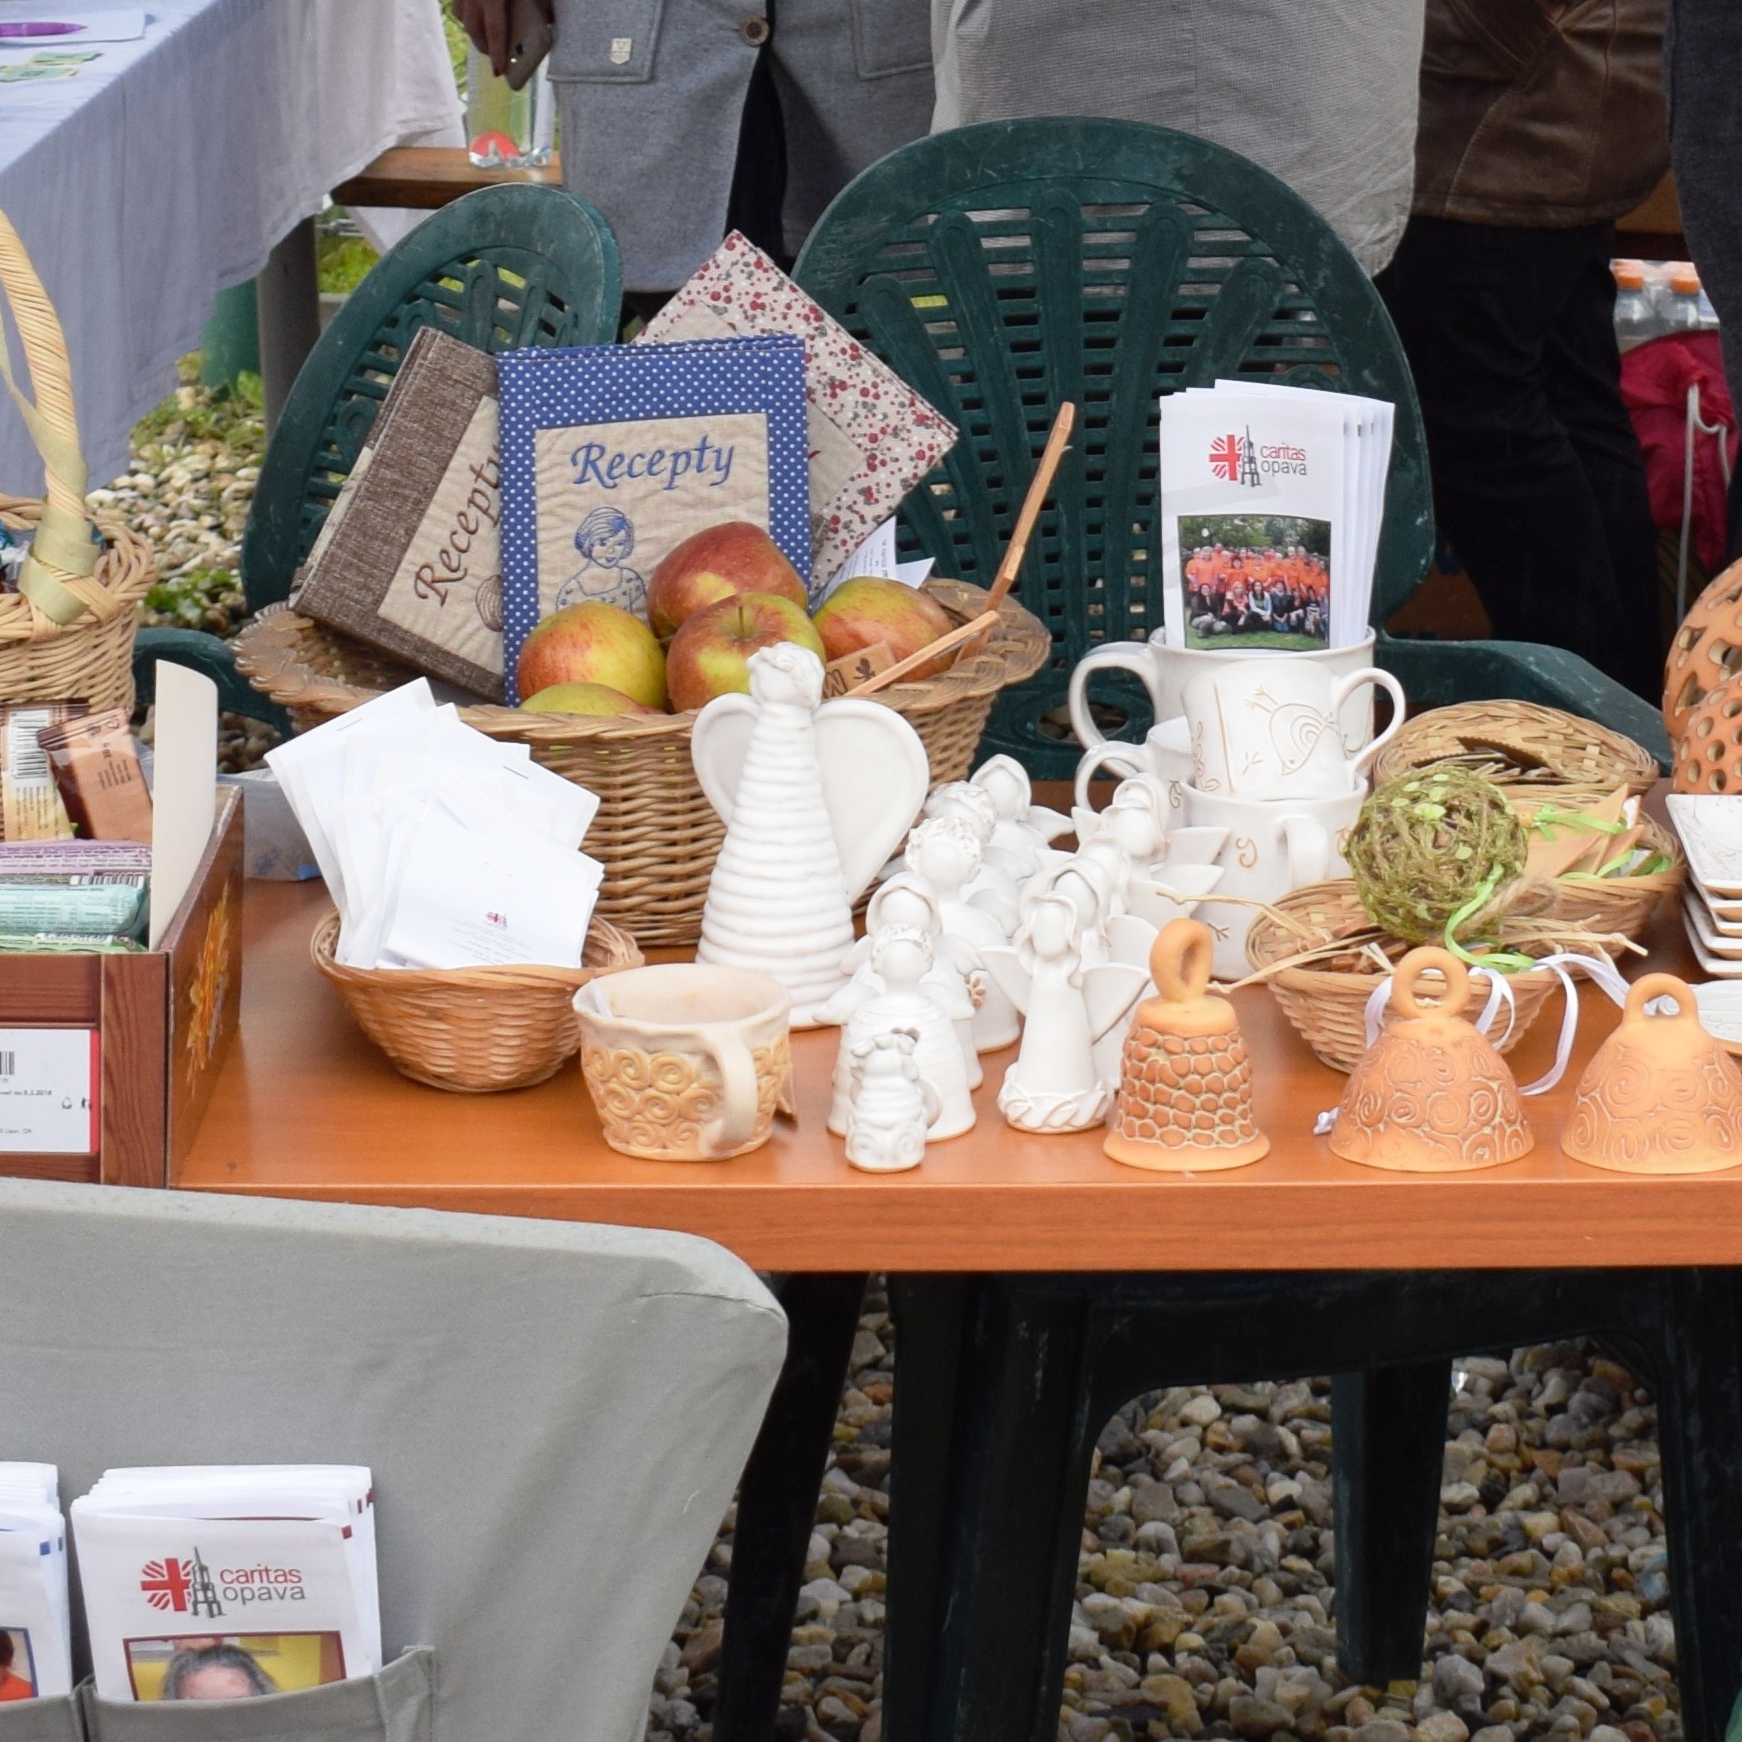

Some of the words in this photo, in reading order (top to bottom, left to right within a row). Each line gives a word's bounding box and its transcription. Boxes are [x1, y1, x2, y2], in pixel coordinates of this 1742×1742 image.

[570, 434, 735, 491] Recepty
[1259, 442, 1307, 461] caritas
[1260, 459, 1308, 477] opava
[218, 1562, 303, 1586] caritas
[223, 1582, 307, 1604] opava
